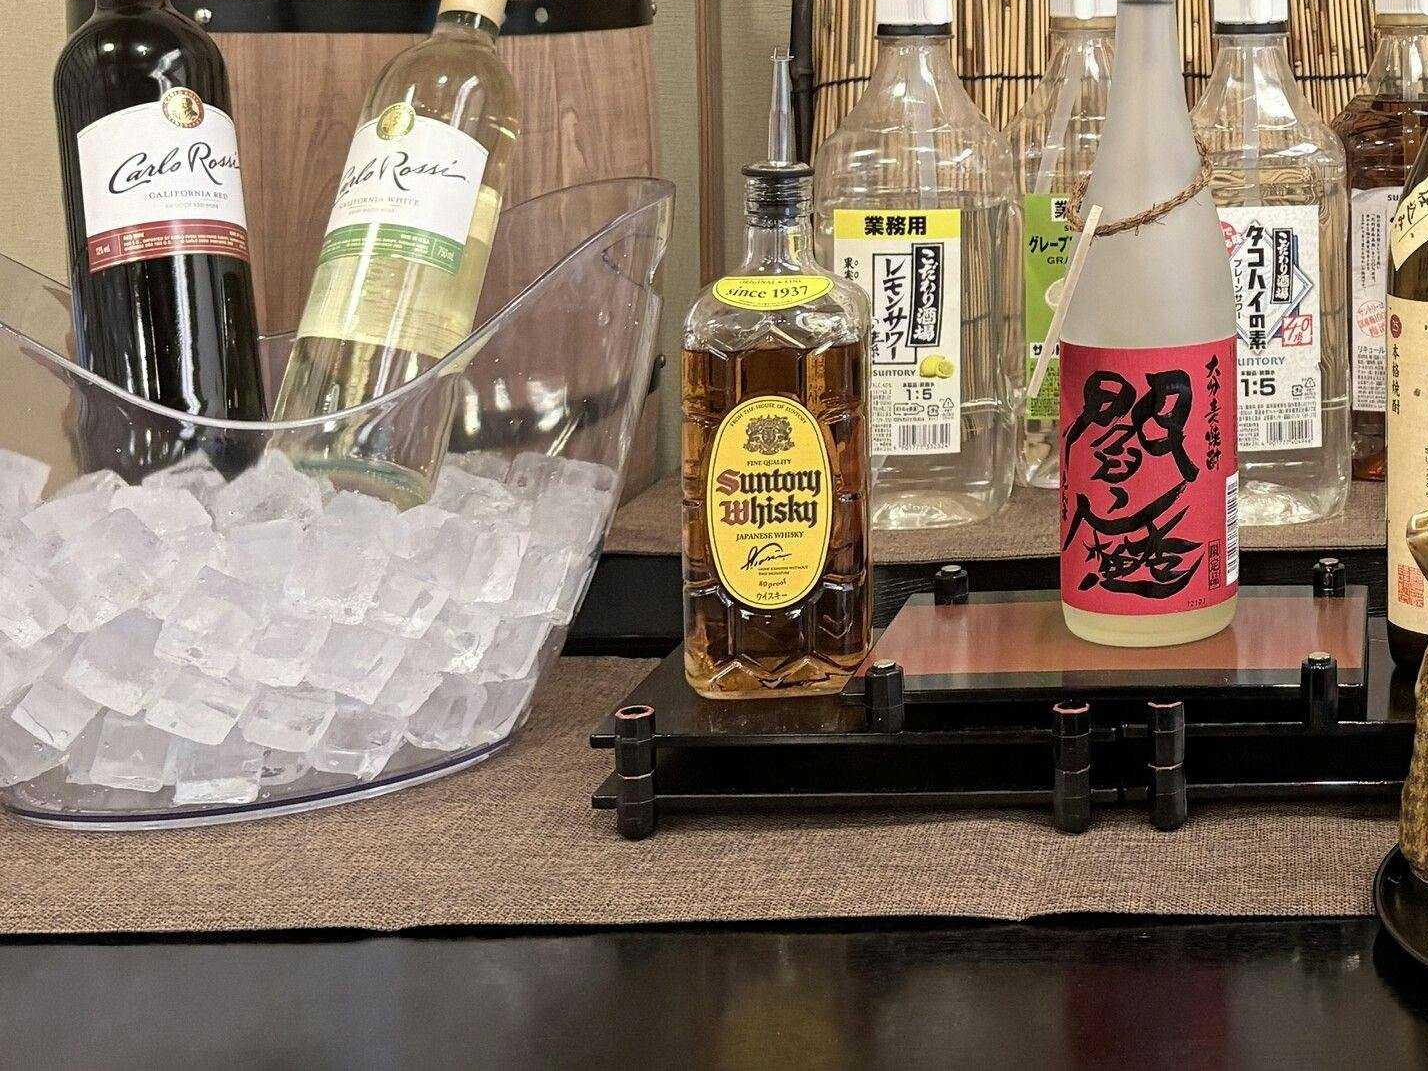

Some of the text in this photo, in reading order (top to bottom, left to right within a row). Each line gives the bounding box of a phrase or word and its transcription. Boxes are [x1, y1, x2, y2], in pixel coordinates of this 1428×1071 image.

[109, 141, 240, 195] Carlo Rossi
[149, 189, 229, 201] CALIFORNIA RED
[864, 215, 928, 236] 業務用
[1274, 231, 1291, 301] こだわり酒場
[725, 285, 809, 299] since 1937
[913, 248, 939, 342] こだわり酒場
[1233, 258, 1243, 320] プレーンサワー
[1245, 225, 1267, 350] タコハイの素
[883, 257, 908, 361] レモンサワー
[1237, 356, 1285, 367] UNTORY
[873, 369, 917, 377] SUNTORY
[1391, 343, 1401, 416] 本格焼酎
[905, 388, 933, 401] 1:5
[1240, 377, 1276, 397] 1:5
[743, 405, 755, 416] THE
[756, 402, 775, 411] HOUSE
[763, 459, 792, 467] QUALITY
[716, 468, 822, 497] Suntory
[719, 495, 818, 529] Whisky
[736, 531, 805, 542] JAPANESE WHISKY
[756, 592, 788, 601] ウイスキー
